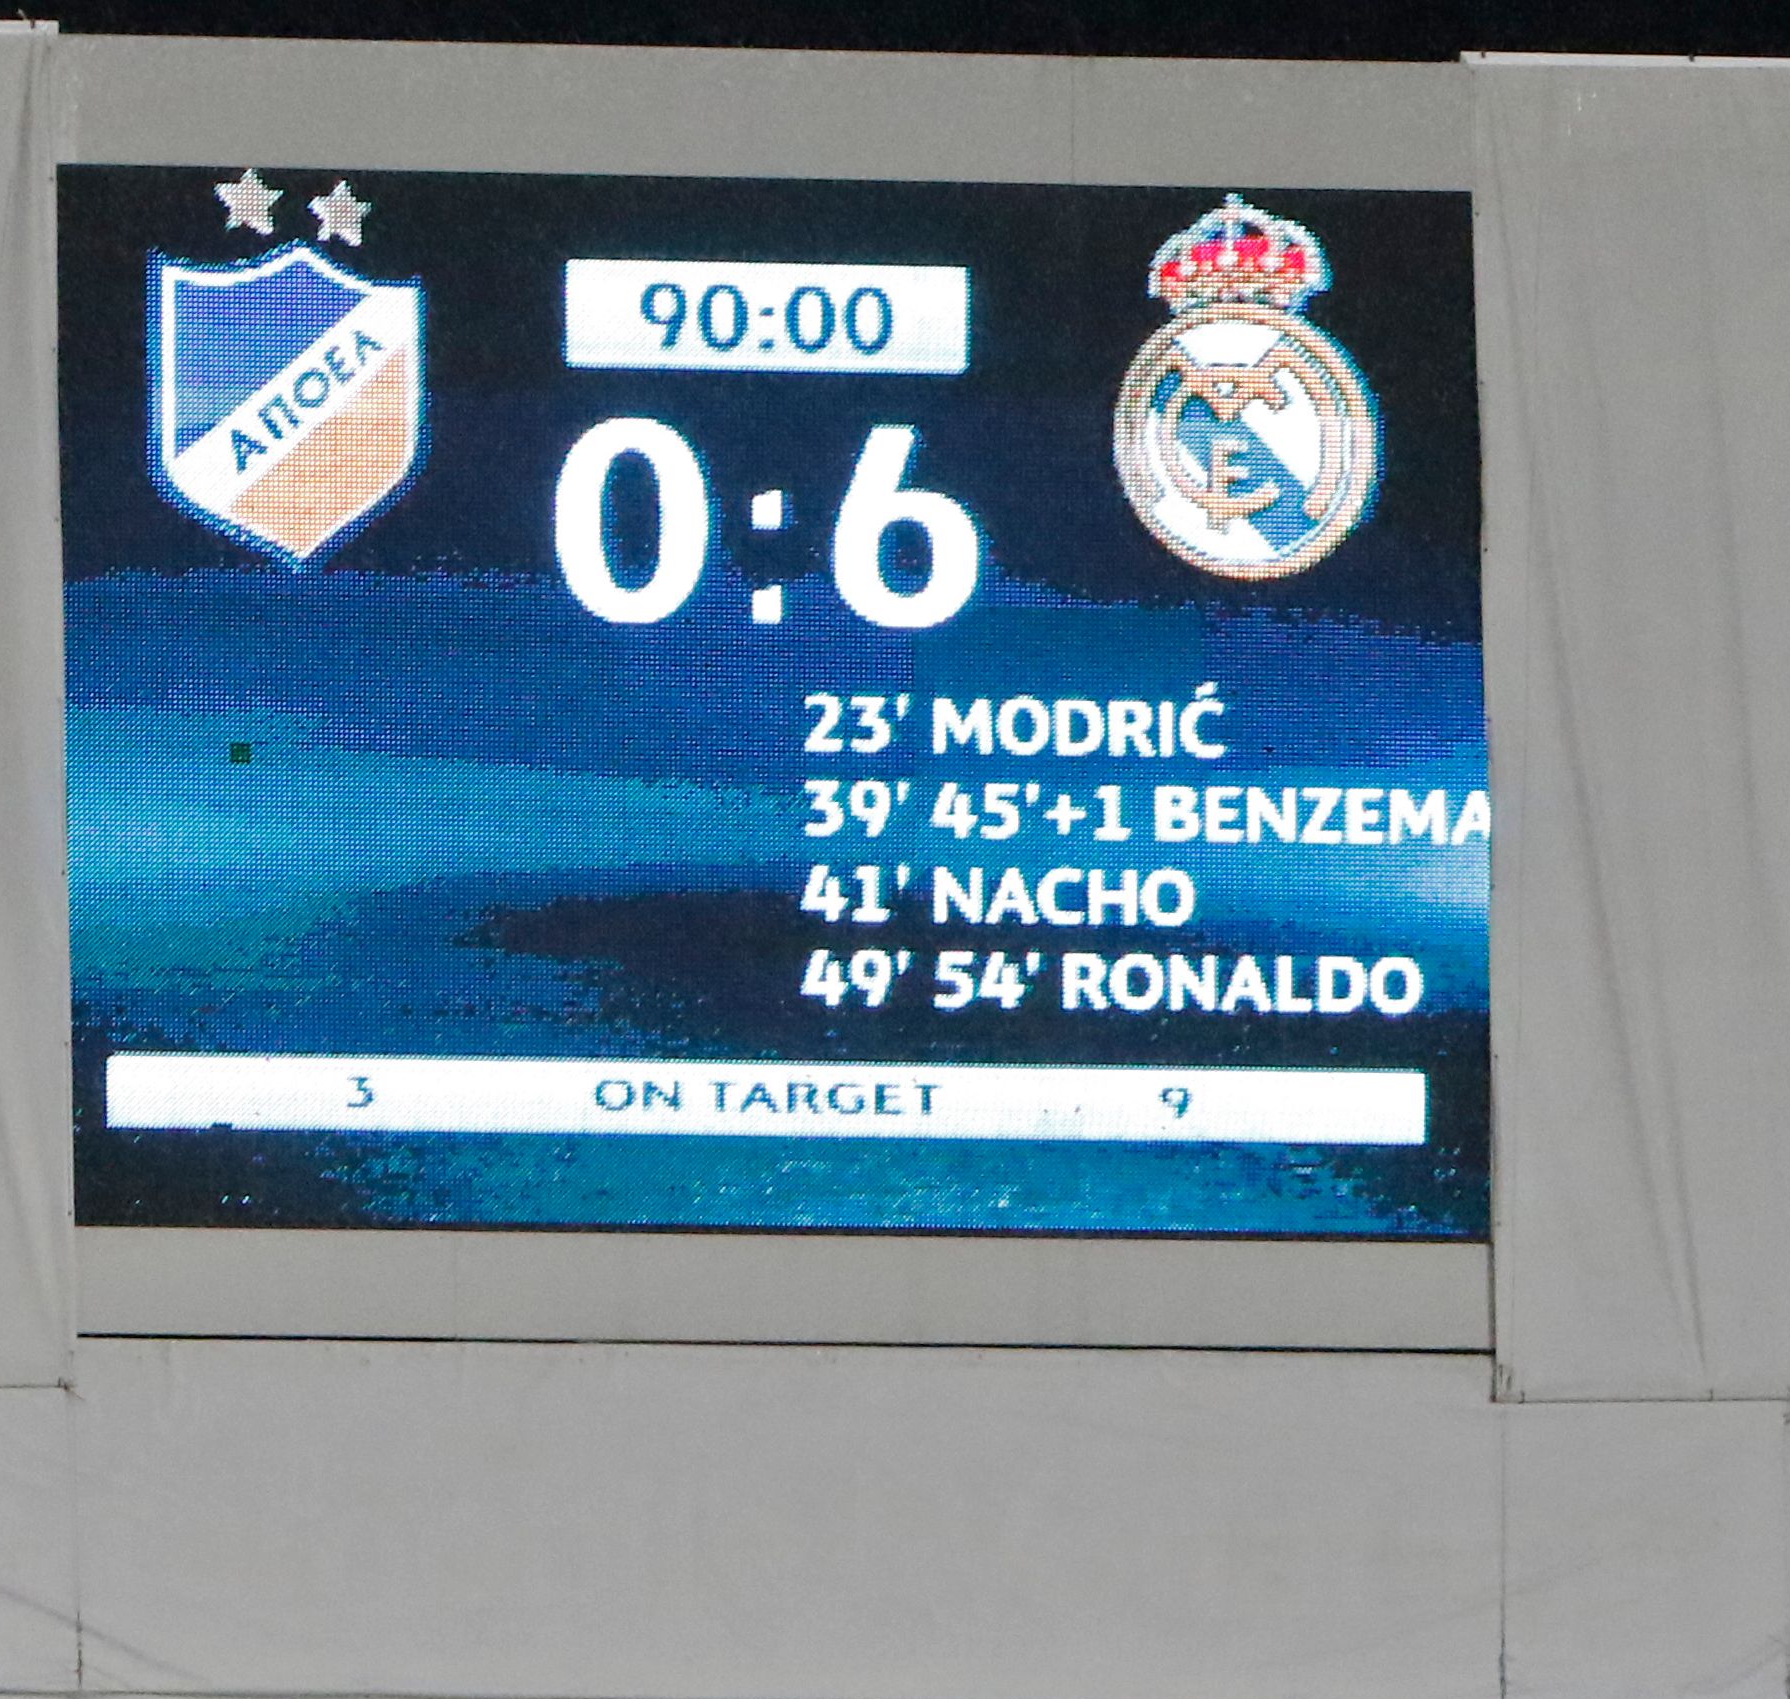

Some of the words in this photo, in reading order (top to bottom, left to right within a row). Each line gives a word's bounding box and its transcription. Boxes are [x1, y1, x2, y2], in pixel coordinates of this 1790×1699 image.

[640, 282, 895, 355] 90:00
[803, 692, 911, 754] 23'
[932, 682, 1229, 759] MODRIĆ
[803, 777, 911, 839] 39'
[930, 782, 1133, 842] 45'+1
[1153, 785, 1492, 845] BENZEMA
[799, 864, 911, 924] 41'
[932, 866, 1196, 927] NACHO
[799, 948, 912, 1010] 49'
[933, 950, 1043, 1012] 54'
[1061, 952, 1425, 1015] RONALDO
[346, 1076, 376, 1110] 3
[595, 1078, 685, 1112] ON
[707, 1080, 943, 1116] TARGET
[1160, 1086, 1193, 1120] 9
